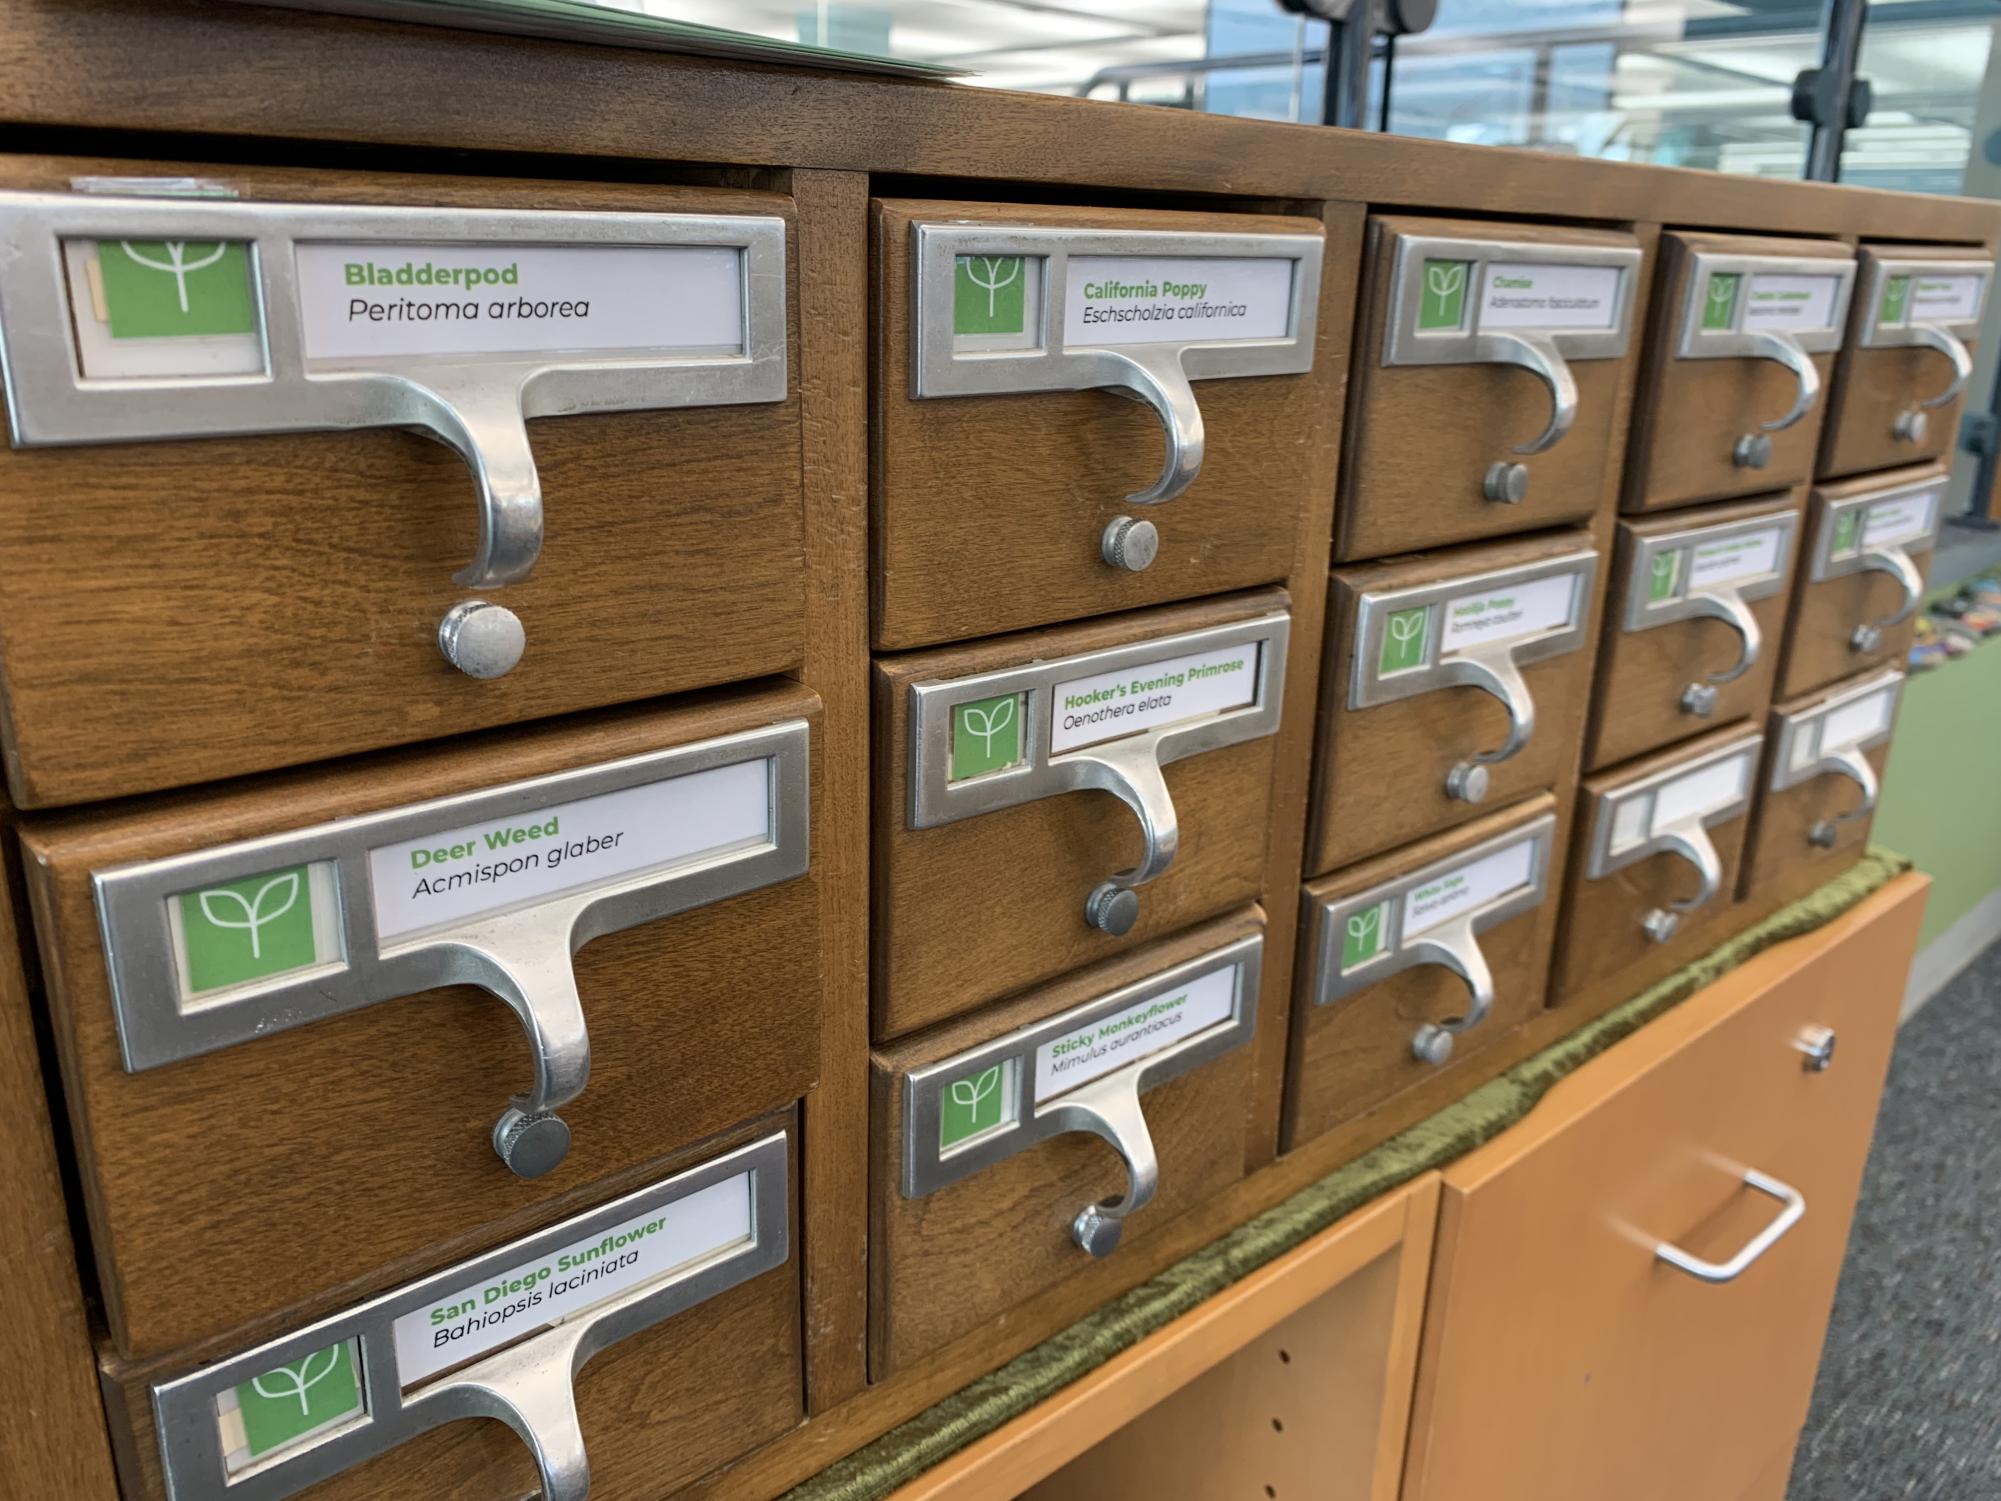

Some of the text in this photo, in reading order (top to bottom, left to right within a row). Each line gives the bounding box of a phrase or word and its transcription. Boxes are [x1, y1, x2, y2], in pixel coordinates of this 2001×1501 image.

[344, 263, 518, 290] Bladderpod
[1084, 280, 1207, 299] California Poppy
[350, 297, 589, 321] Peritoma arborea
[1083, 301, 1247, 323] Eschscholzia californica
[1065, 659, 1244, 710] Hooker's Evening Primrose
[1063, 694, 1172, 730] Oenothera elata
[411, 816, 559, 869] Deer Weed
[412, 831, 624, 899] Acmispon glaber
[1051, 1011, 1183, 1076] Mimulus aurantiacus
[1052, 993, 1188, 1058] Sticky Monkeyflower
[430, 1217, 666, 1326] San Diego Sunflower
[433, 1250, 639, 1348] Bahiopsis laciniata
